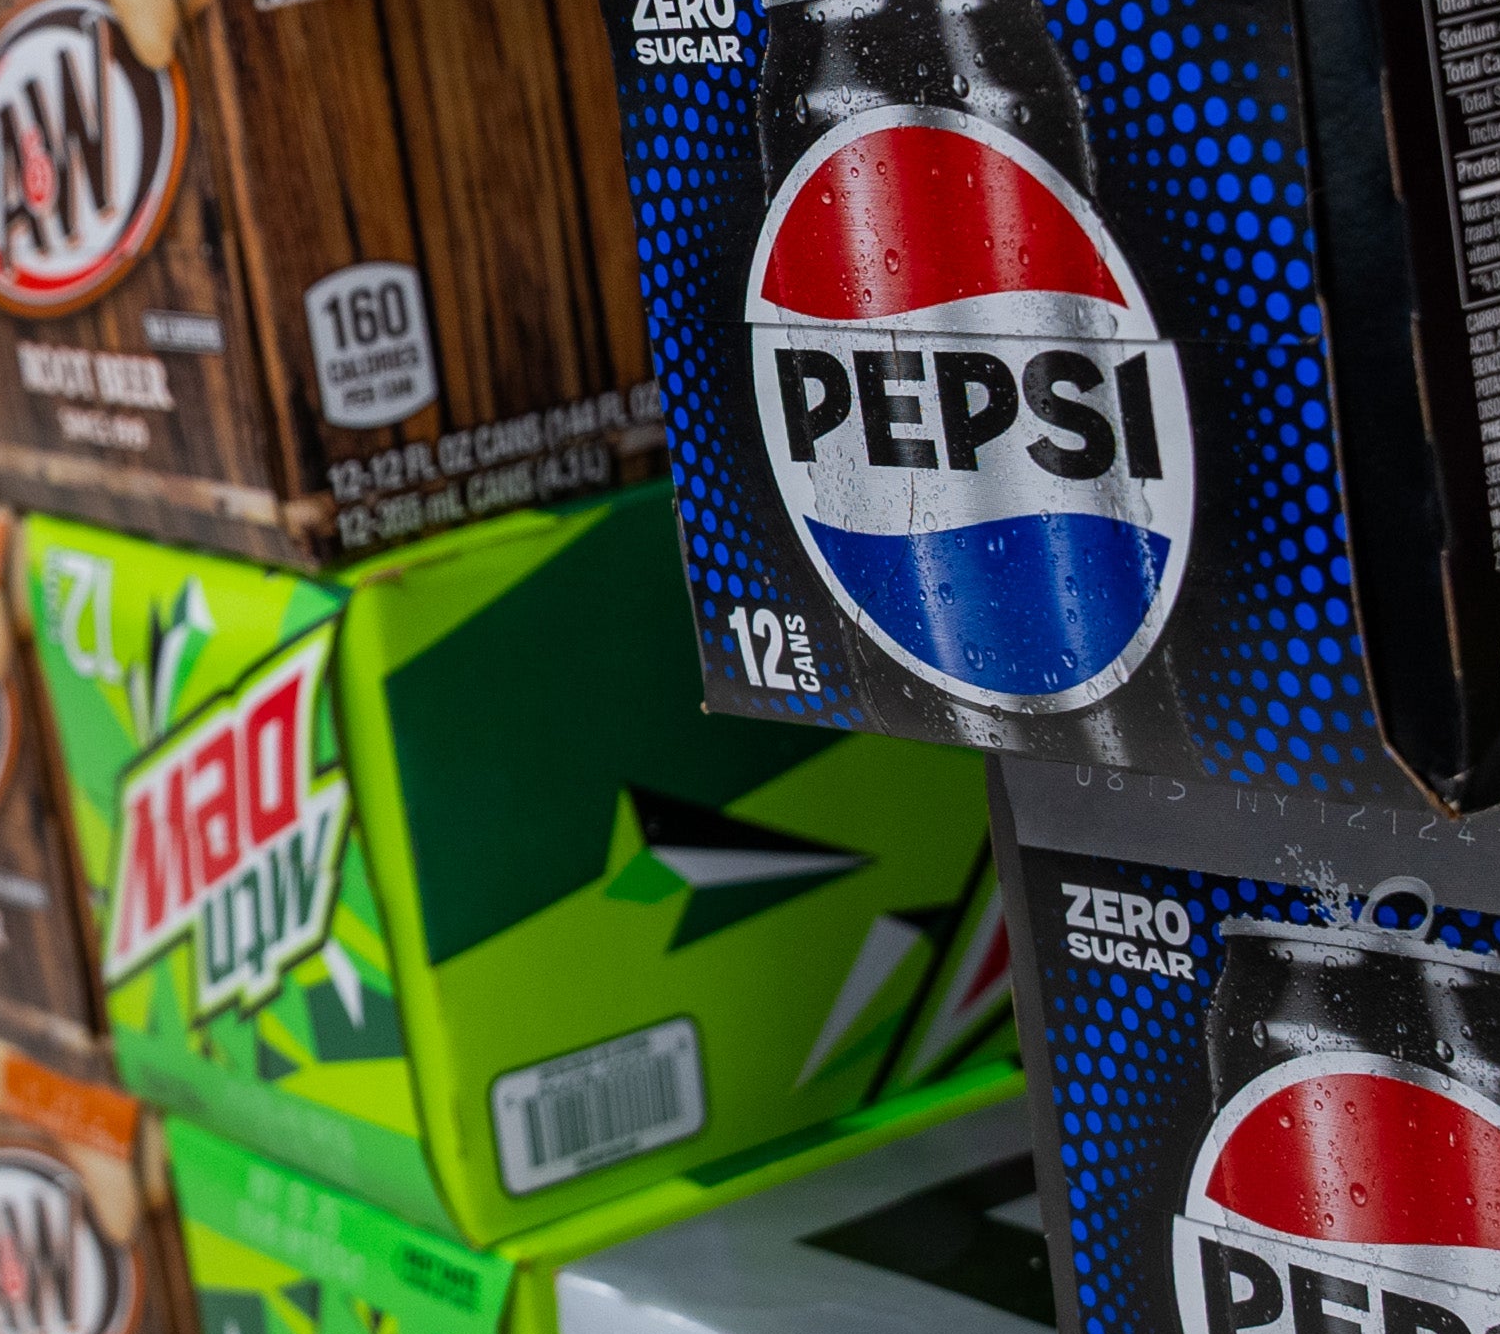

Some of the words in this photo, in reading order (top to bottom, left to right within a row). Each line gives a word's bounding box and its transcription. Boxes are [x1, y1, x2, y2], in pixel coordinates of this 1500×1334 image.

[635, 35, 743, 66] SUGAR
[320, 282, 410, 350] 160
[773, 348, 1164, 481] PEPSI
[728, 607, 798, 693] 12
[791, 613, 821, 694] CANS
[1060, 881, 1191, 946] ZERO
[1068, 934, 1197, 982] SUGAR
